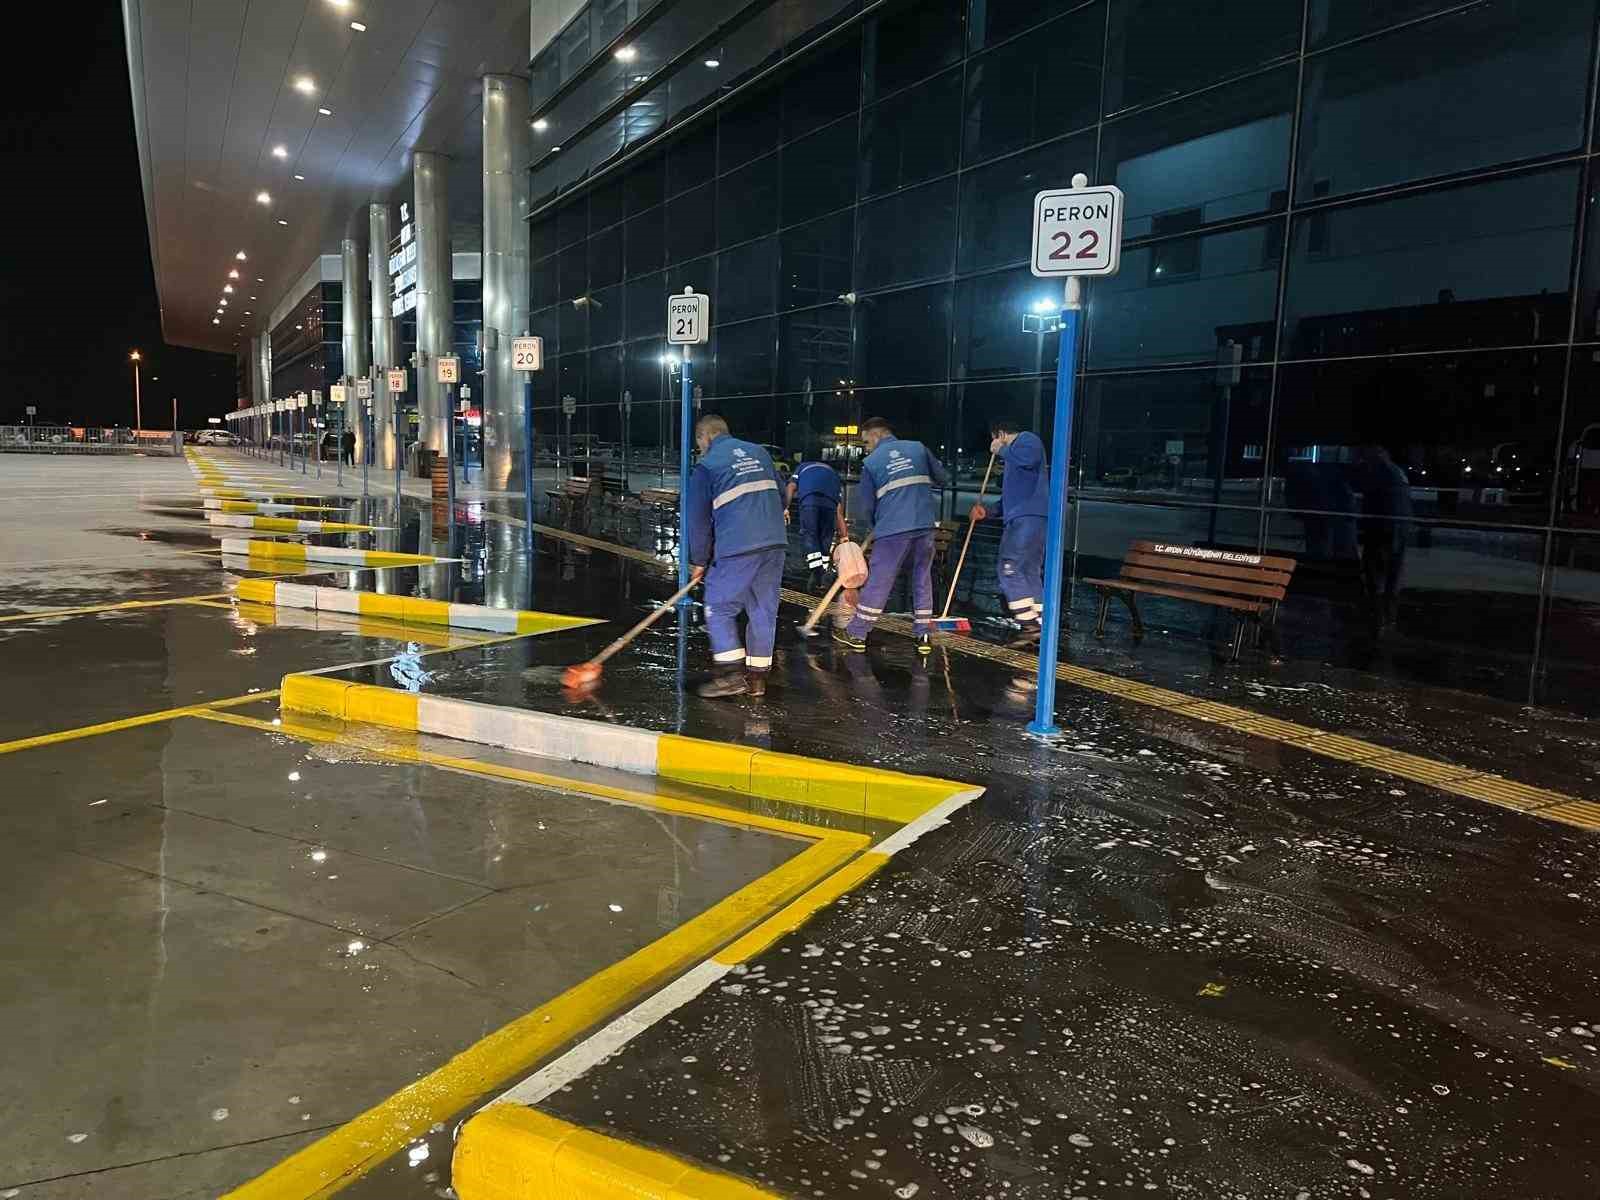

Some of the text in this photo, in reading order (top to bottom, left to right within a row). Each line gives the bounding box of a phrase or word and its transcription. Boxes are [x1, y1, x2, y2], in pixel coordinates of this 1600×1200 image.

[1043, 204, 1109, 222] PERON
[1048, 229, 1099, 260] 22
[671, 304, 698, 314] PERON
[676, 318, 693, 335] 21
[517, 353, 534, 364] 20
[442, 369, 453, 378] 19
